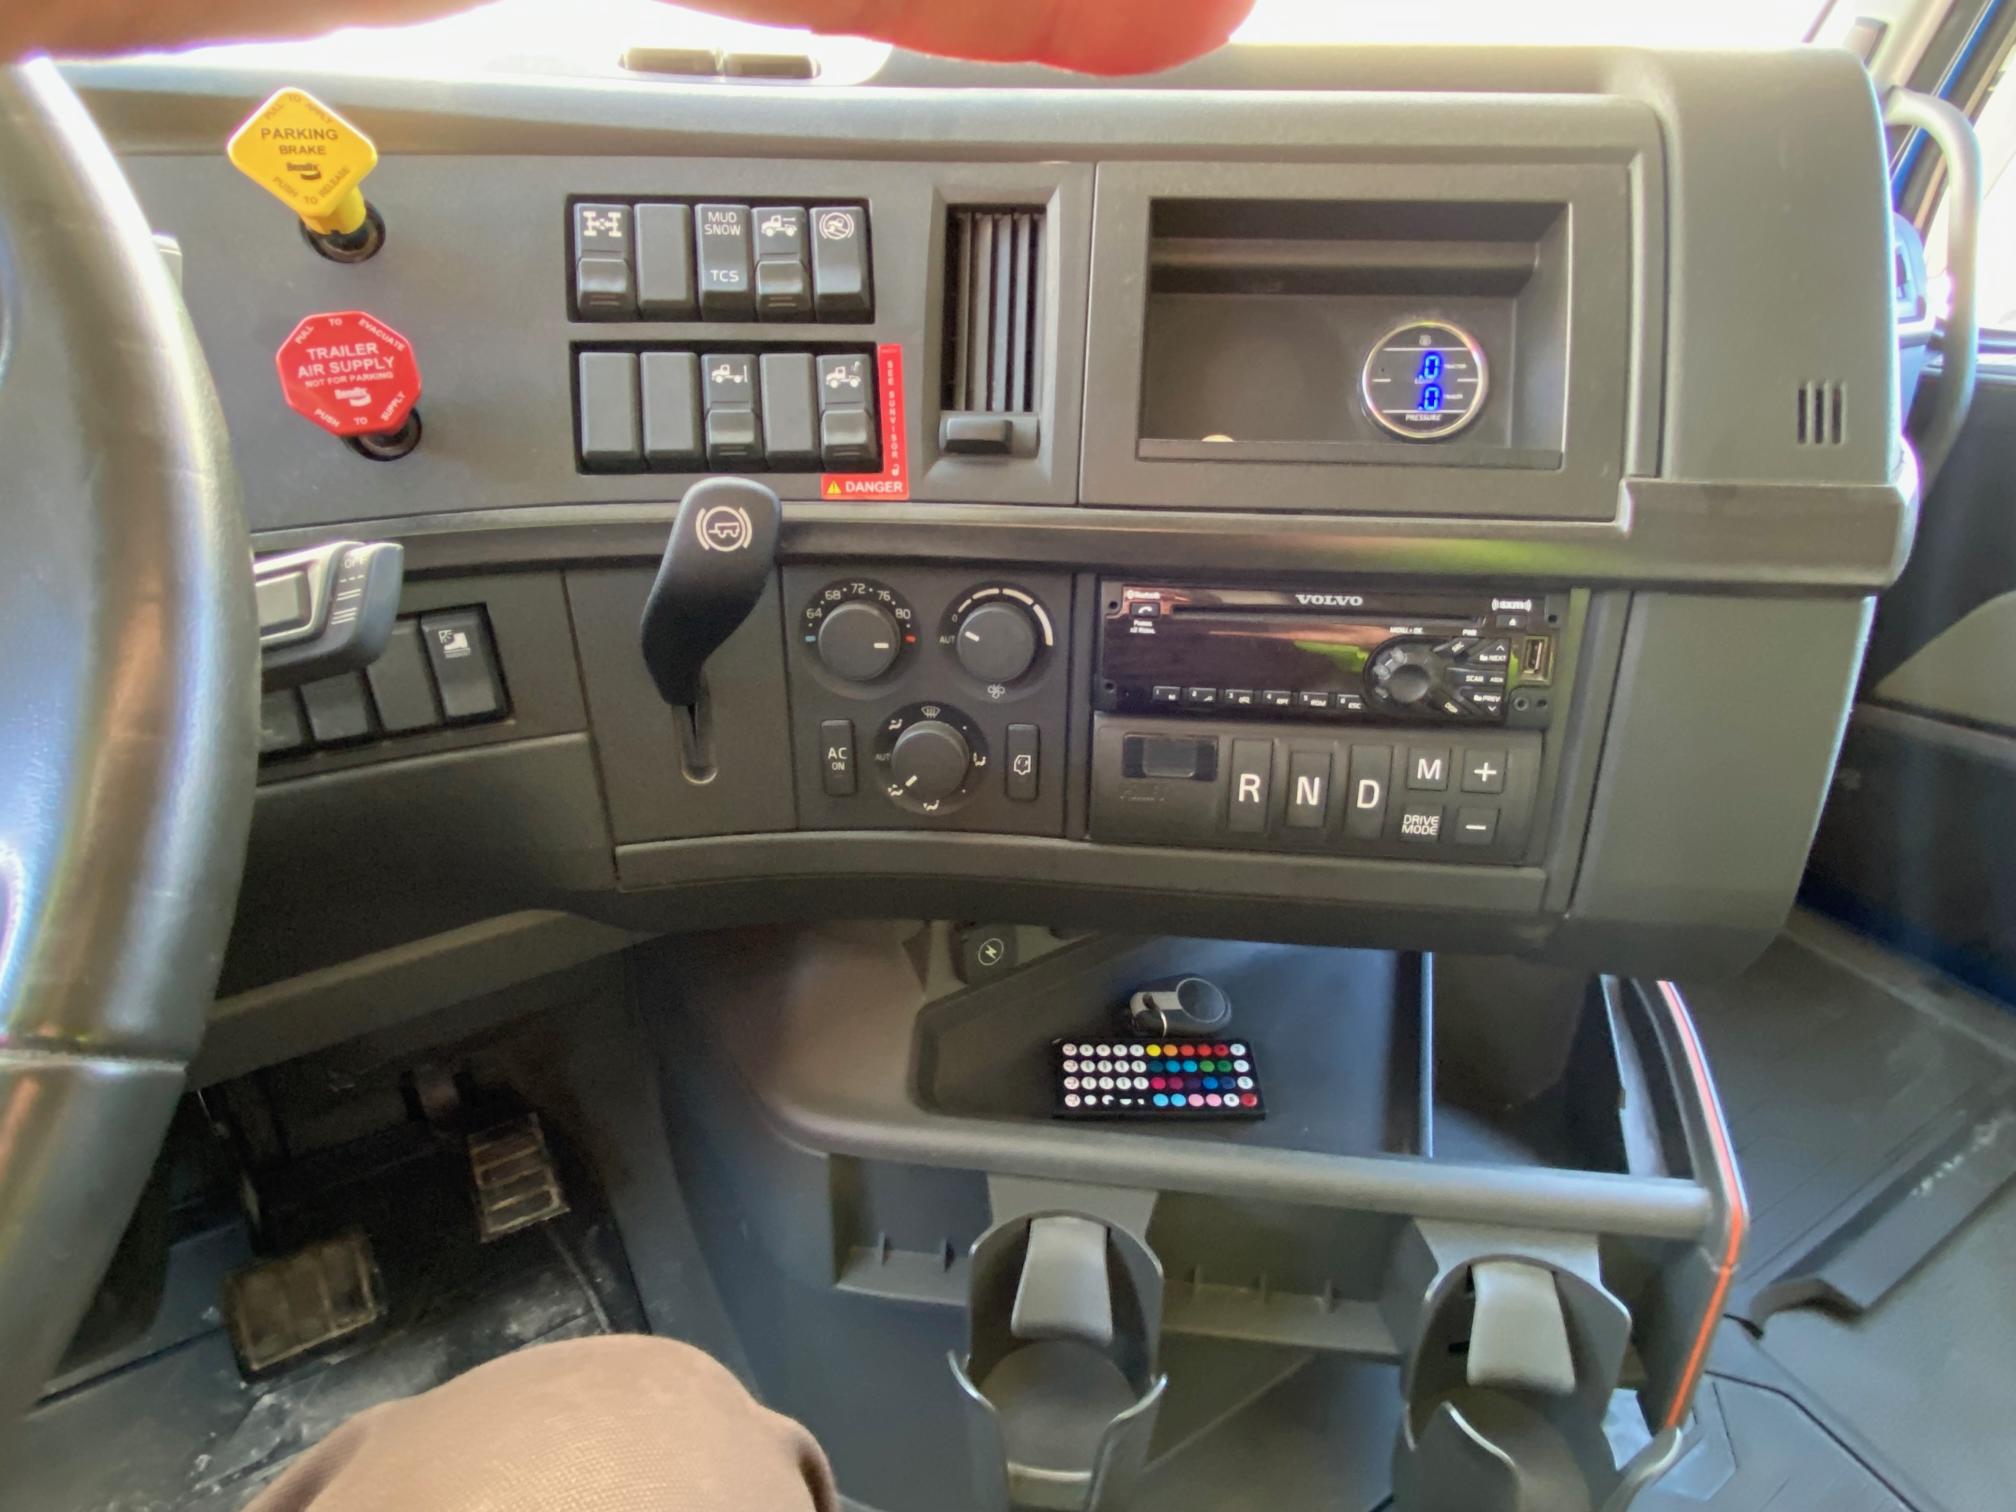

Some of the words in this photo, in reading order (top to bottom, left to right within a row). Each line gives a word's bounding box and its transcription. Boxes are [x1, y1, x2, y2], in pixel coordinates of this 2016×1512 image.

[287, 94, 301, 102] TO
[261, 127, 338, 140] PARKING
[279, 144, 326, 155] BRAKE
[272, 176, 298, 198] PUSH
[304, 196, 318, 205] TO
[319, 166, 352, 198] RELEASE
[707, 211, 737, 223] MUD
[704, 223, 741, 236] SNOW
[710, 270, 739, 282] TCS
[294, 325, 315, 344] PULL
[328, 318, 343, 326] TO
[358, 318, 406, 351] EVACUATE
[306, 342, 379, 360] TRAILER
[298, 364, 325, 378] AIR
[328, 356, 395, 374] SUPPLY
[886, 360, 894, 386] SEE
[305, 378, 325, 388] NOT
[327, 375, 348, 384] FOR
[349, 371, 394, 382] PARKING
[314, 408, 340, 427] PUSH
[353, 417, 368, 425] TO
[380, 391, 406, 422] SUPPLY
[888, 391, 899, 459] SUNVISOR
[845, 481, 903, 493] DANGER
[806, 608, 823, 618] 64
[825, 590, 841, 601] 68
[851, 583, 867, 594] 72
[877, 590, 891, 601] 76
[895, 608, 911, 620] 80
[1296, 594, 1363, 606] VOLVO
[827, 747, 847, 760] AC
[832, 762, 845, 771] ON
[1417, 759, 1441, 779] M
[1238, 773, 1261, 803] R
[1296, 776, 1320, 805] N
[1356, 779, 1380, 809] D
[1403, 814, 1439, 826] DRIVE
[1401, 825, 1438, 836] MODE
